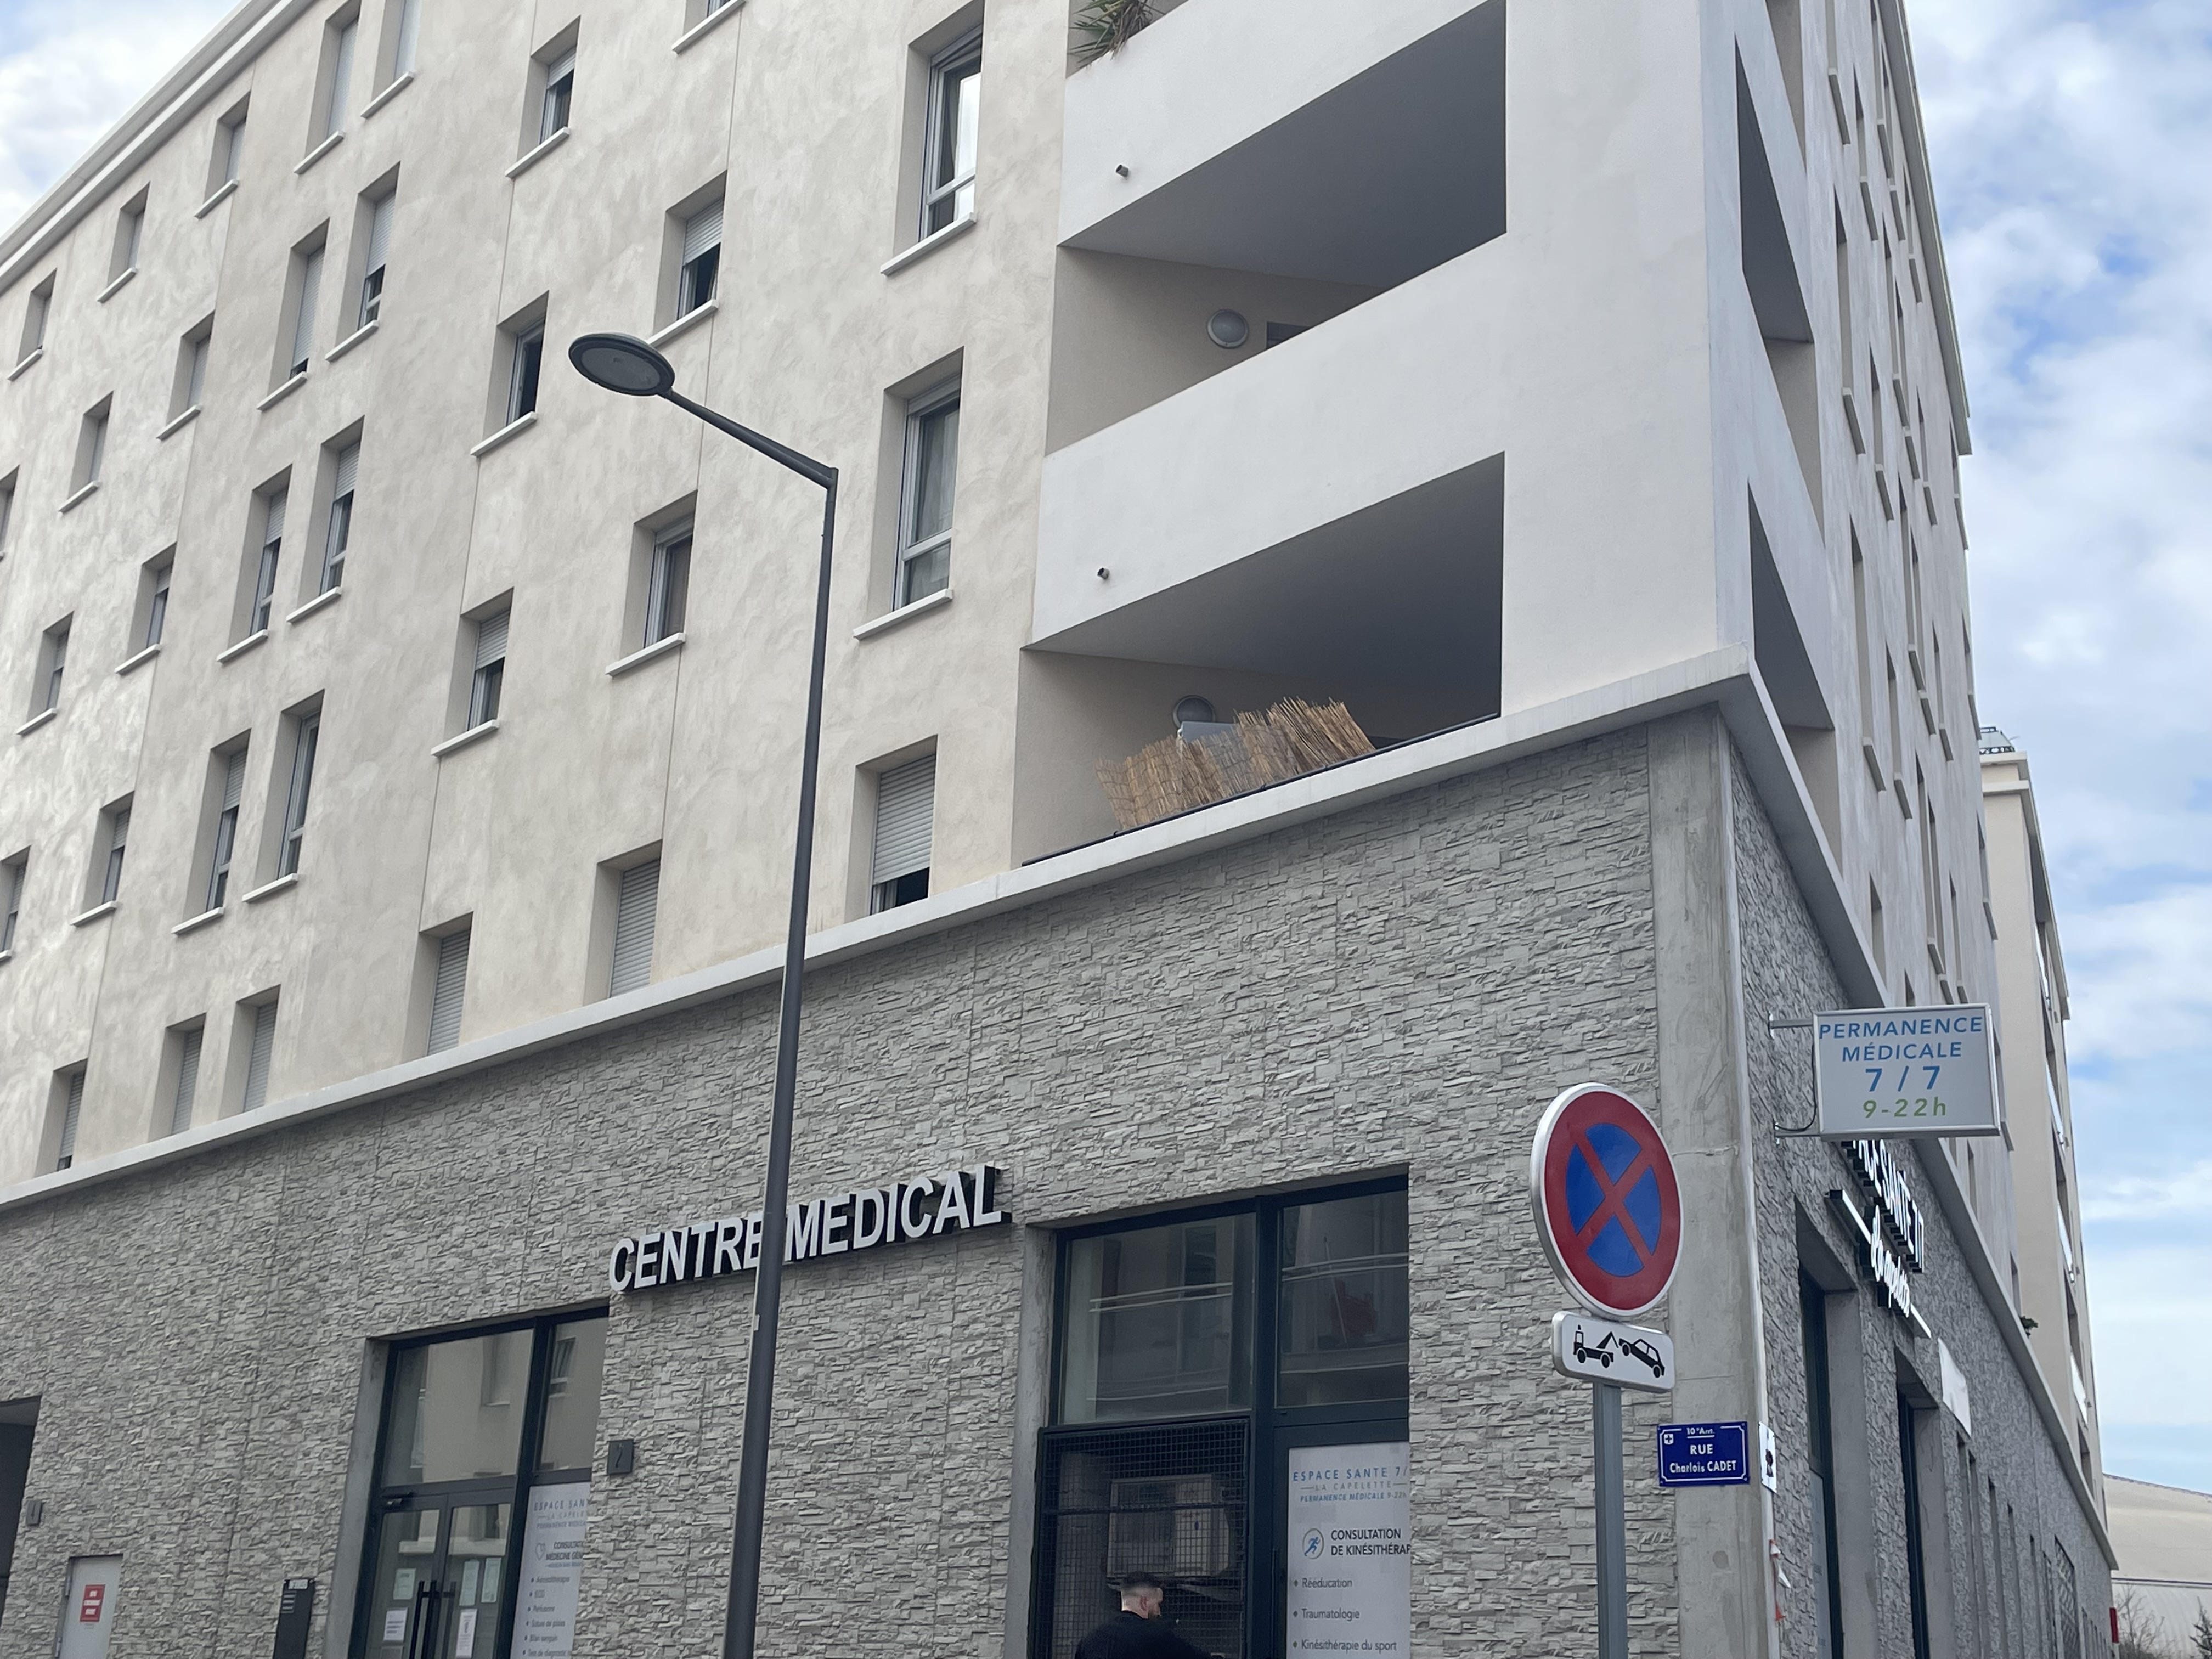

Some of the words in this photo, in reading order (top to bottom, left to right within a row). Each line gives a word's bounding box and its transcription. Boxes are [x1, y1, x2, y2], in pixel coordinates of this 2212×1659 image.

[1819, 1016, 1983, 1040] PERMANENCE
[1842, 1041, 1962, 1062] MÉDICALE
[1863, 1096, 1946, 1119] 9-22h
[608, 1211, 764, 1292] CENTRE
[784, 1165, 1005, 1261] MEDICAL
[1690, 1444, 1713, 1455] RUE
[1293, 1469, 1339, 1481] ESPACE
[1347, 1467, 1387, 1480] SANTE
[1669, 1462, 1705, 1474] Charlois
[1707, 1460, 1737, 1472] CADET
[1315, 1483, 1327, 1492] LA
[1333, 1481, 1392, 1491] CAPELETTE
[1300, 1493, 1347, 1502] PERMANENCE
[1330, 1528, 1402, 1541] CONSULTATION
[1330, 1545, 1344, 1556] DE
[1301, 1577, 1353, 1588] Rééducation
[1301, 1607, 1361, 1622] Traumatologie
[1301, 1639, 1359, 1654] Kinésithérapie
[1361, 1639, 1373, 1651] du
[1375, 1641, 1397, 1654] sport
